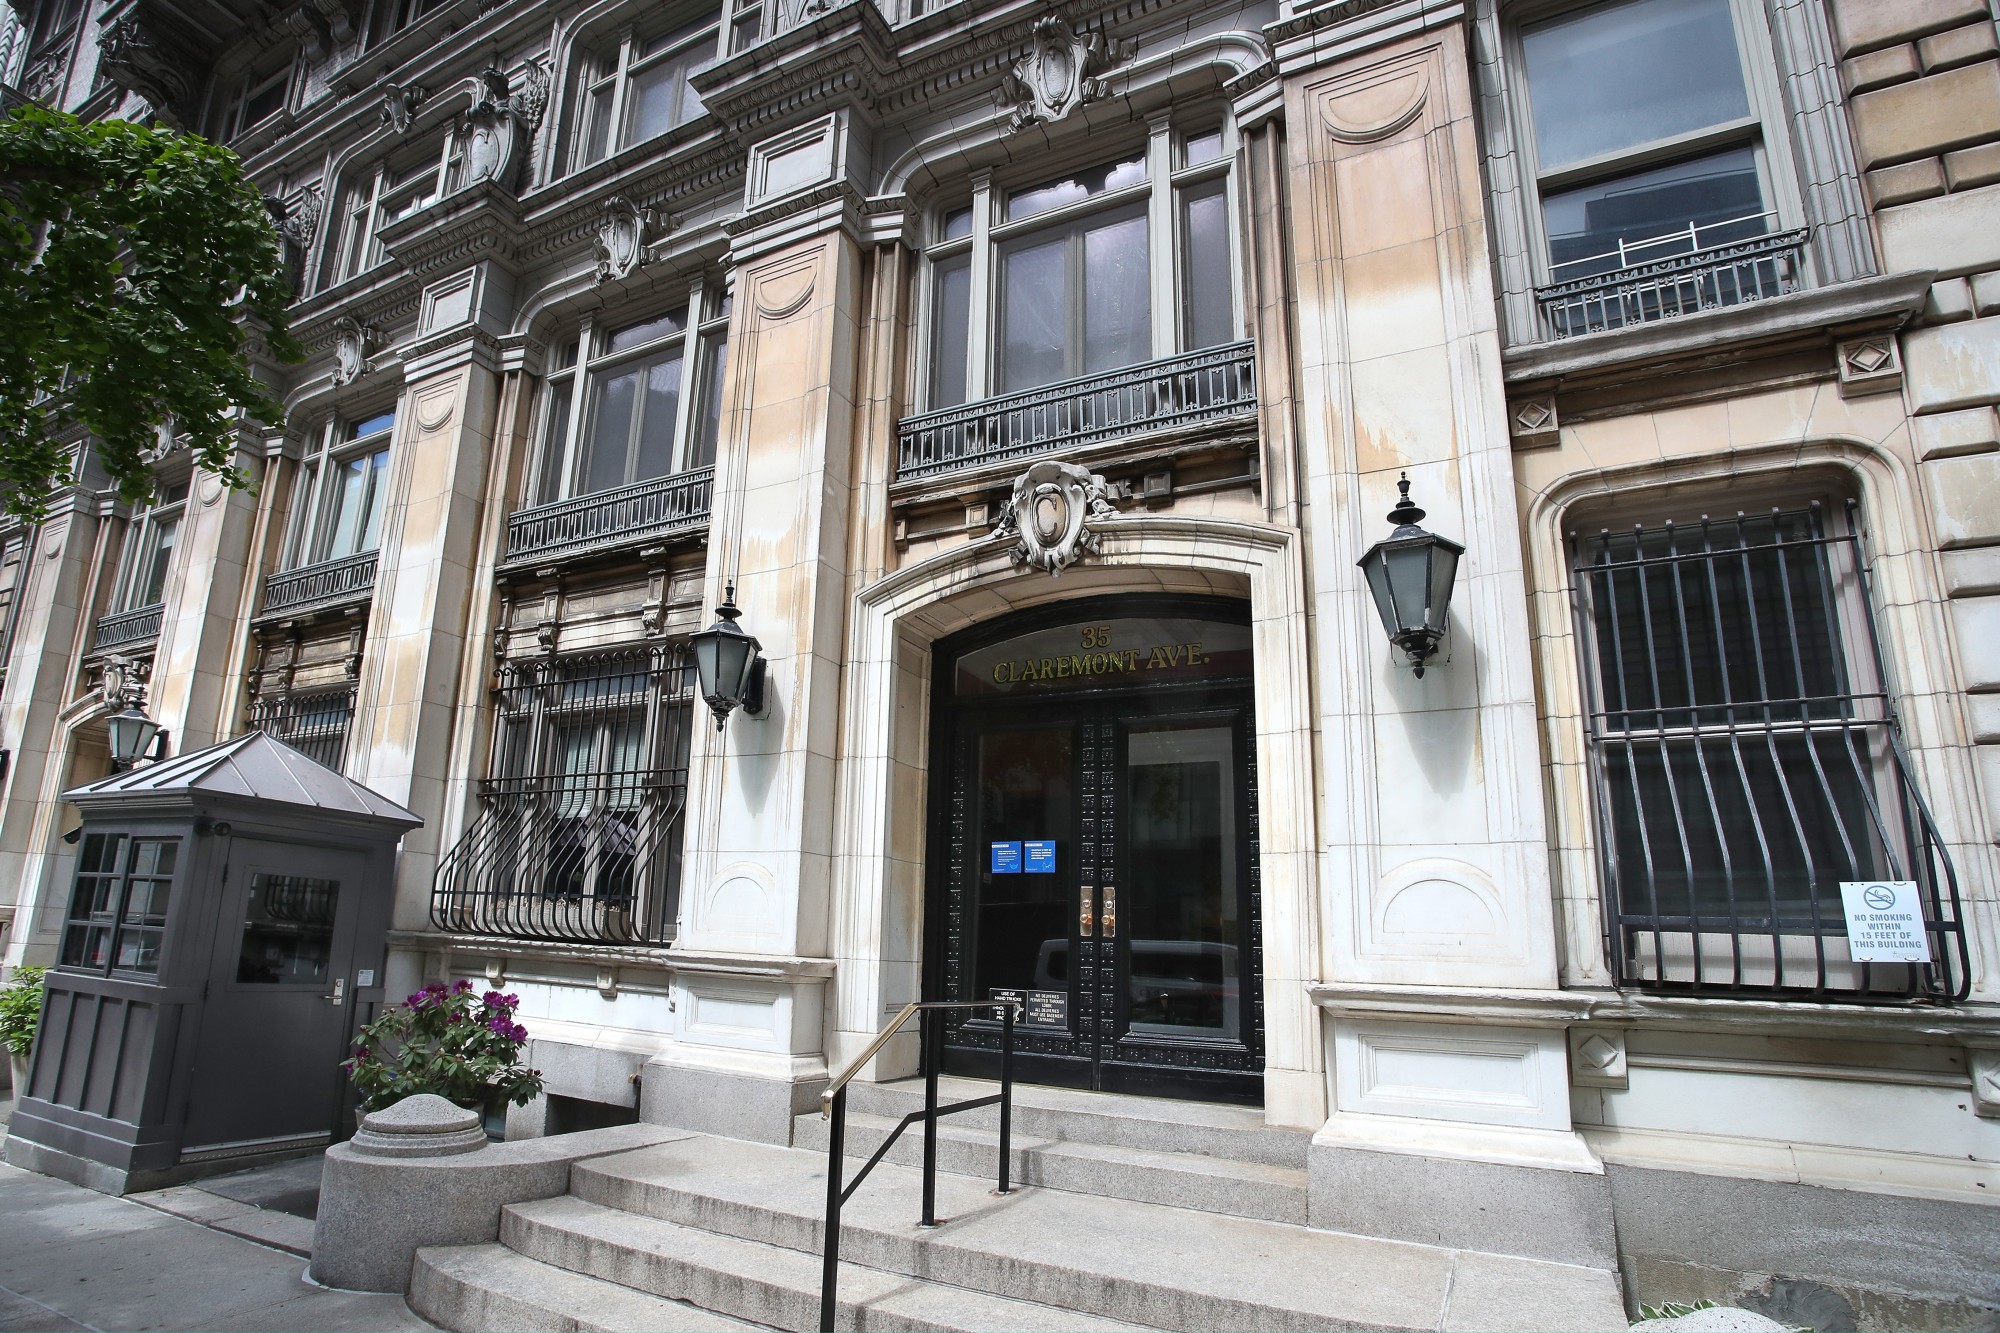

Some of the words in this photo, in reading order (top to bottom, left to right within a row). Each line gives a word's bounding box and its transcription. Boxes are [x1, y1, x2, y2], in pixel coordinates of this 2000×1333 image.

[1081, 625, 1112, 649] 35
[993, 649, 1141, 683] CLAREMONT
[1145, 642, 1210, 669] AVE.
